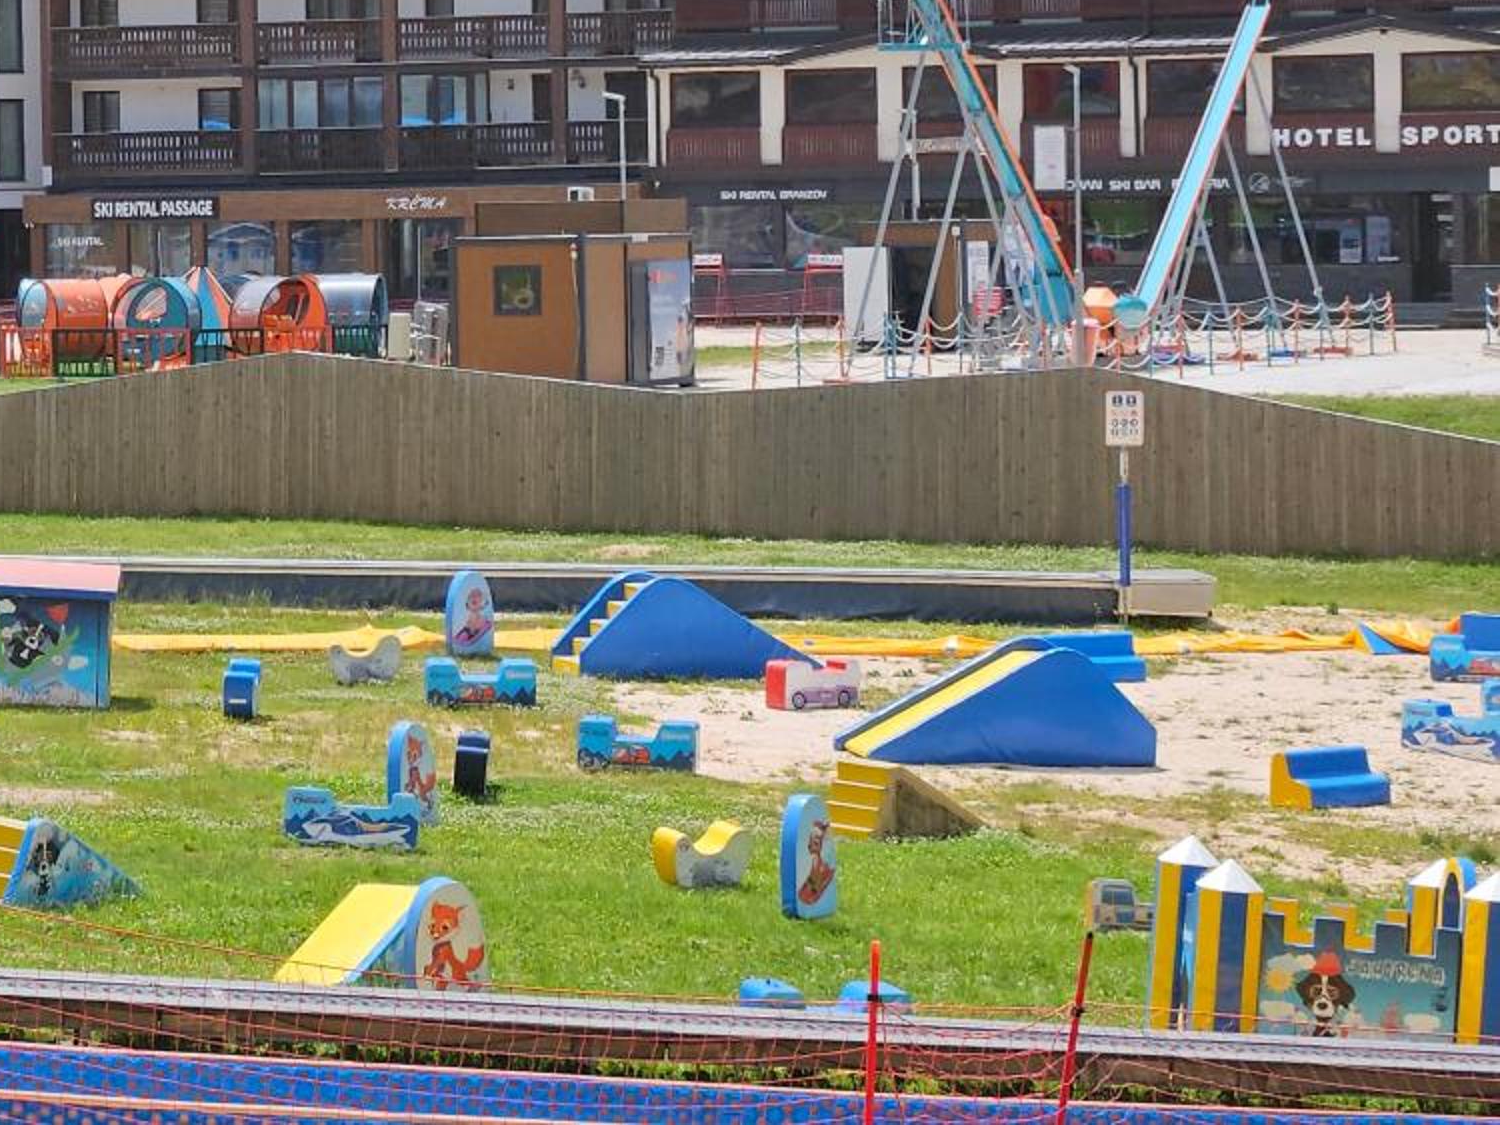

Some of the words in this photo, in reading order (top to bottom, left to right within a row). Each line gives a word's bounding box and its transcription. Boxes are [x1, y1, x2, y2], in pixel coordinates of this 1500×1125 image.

[1272, 127, 1371, 147] HOTEL
[1401, 125, 1500, 146] SPORT
[94, 202, 113, 218] SKI
[115, 201, 160, 217] RENTAL
[161, 200, 213, 216] PASSAGE
